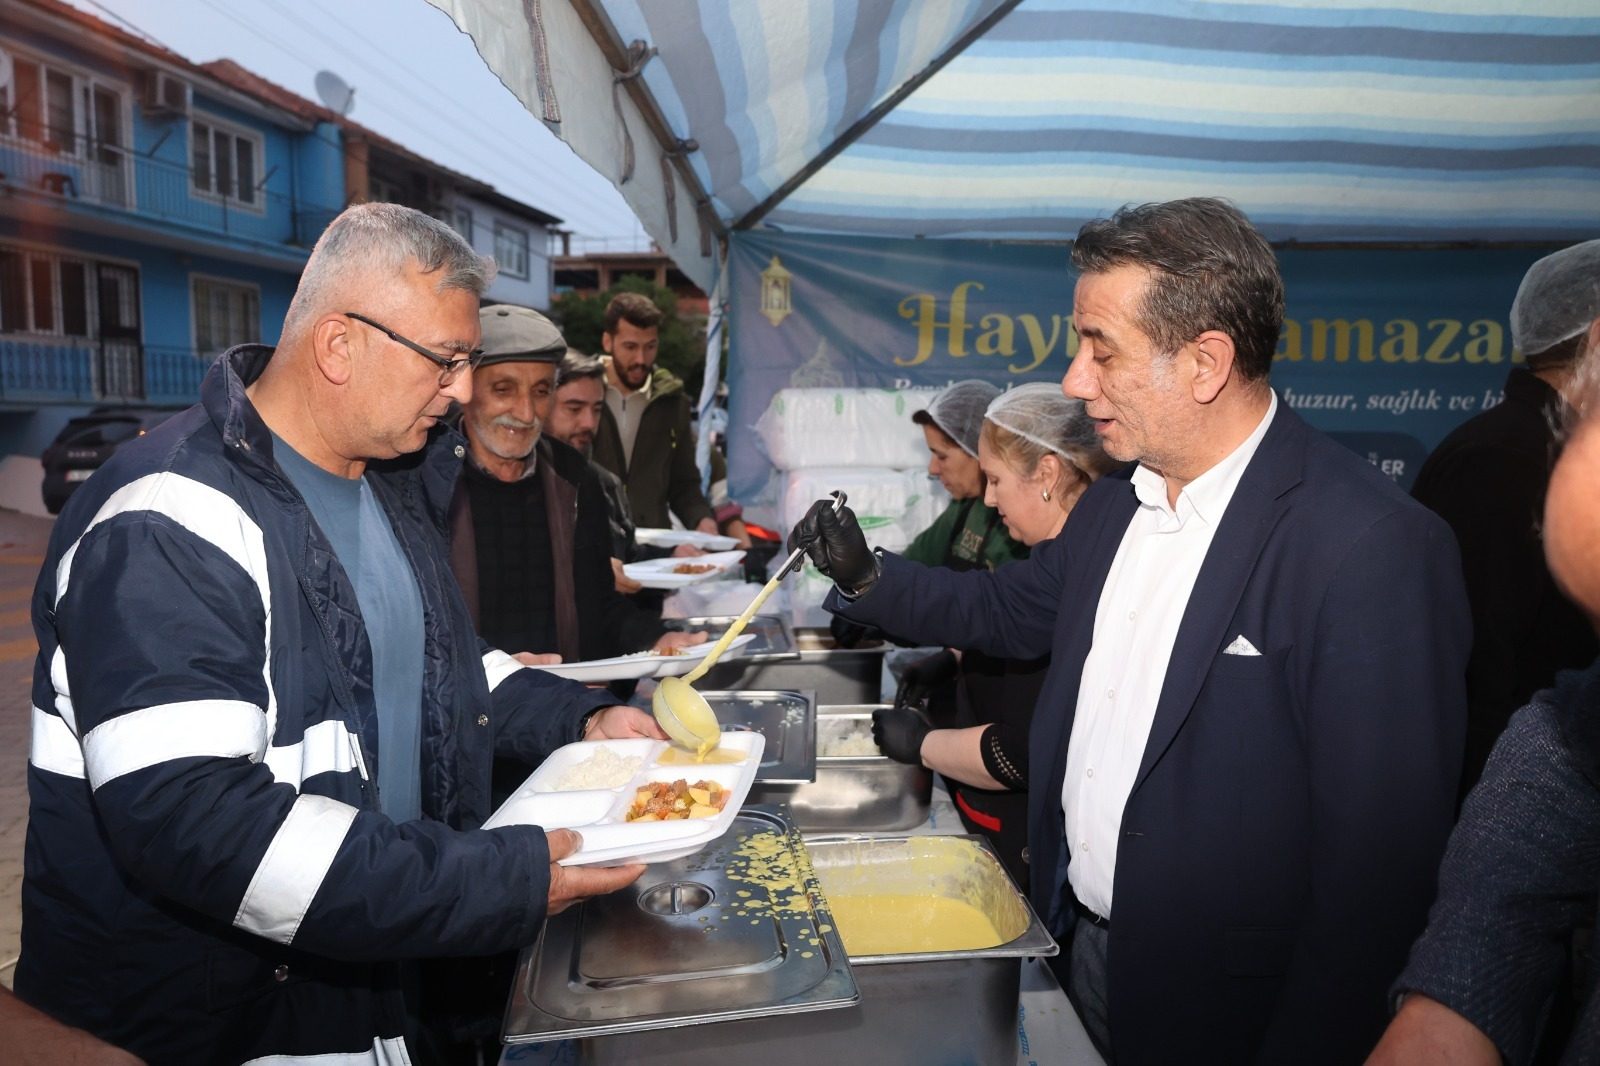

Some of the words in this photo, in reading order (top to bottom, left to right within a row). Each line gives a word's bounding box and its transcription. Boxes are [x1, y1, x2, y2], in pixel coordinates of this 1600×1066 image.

[1283, 387, 1357, 412] huzur,
[1366, 389, 1441, 415] sağlık
[1448, 396, 1475, 410] ve
